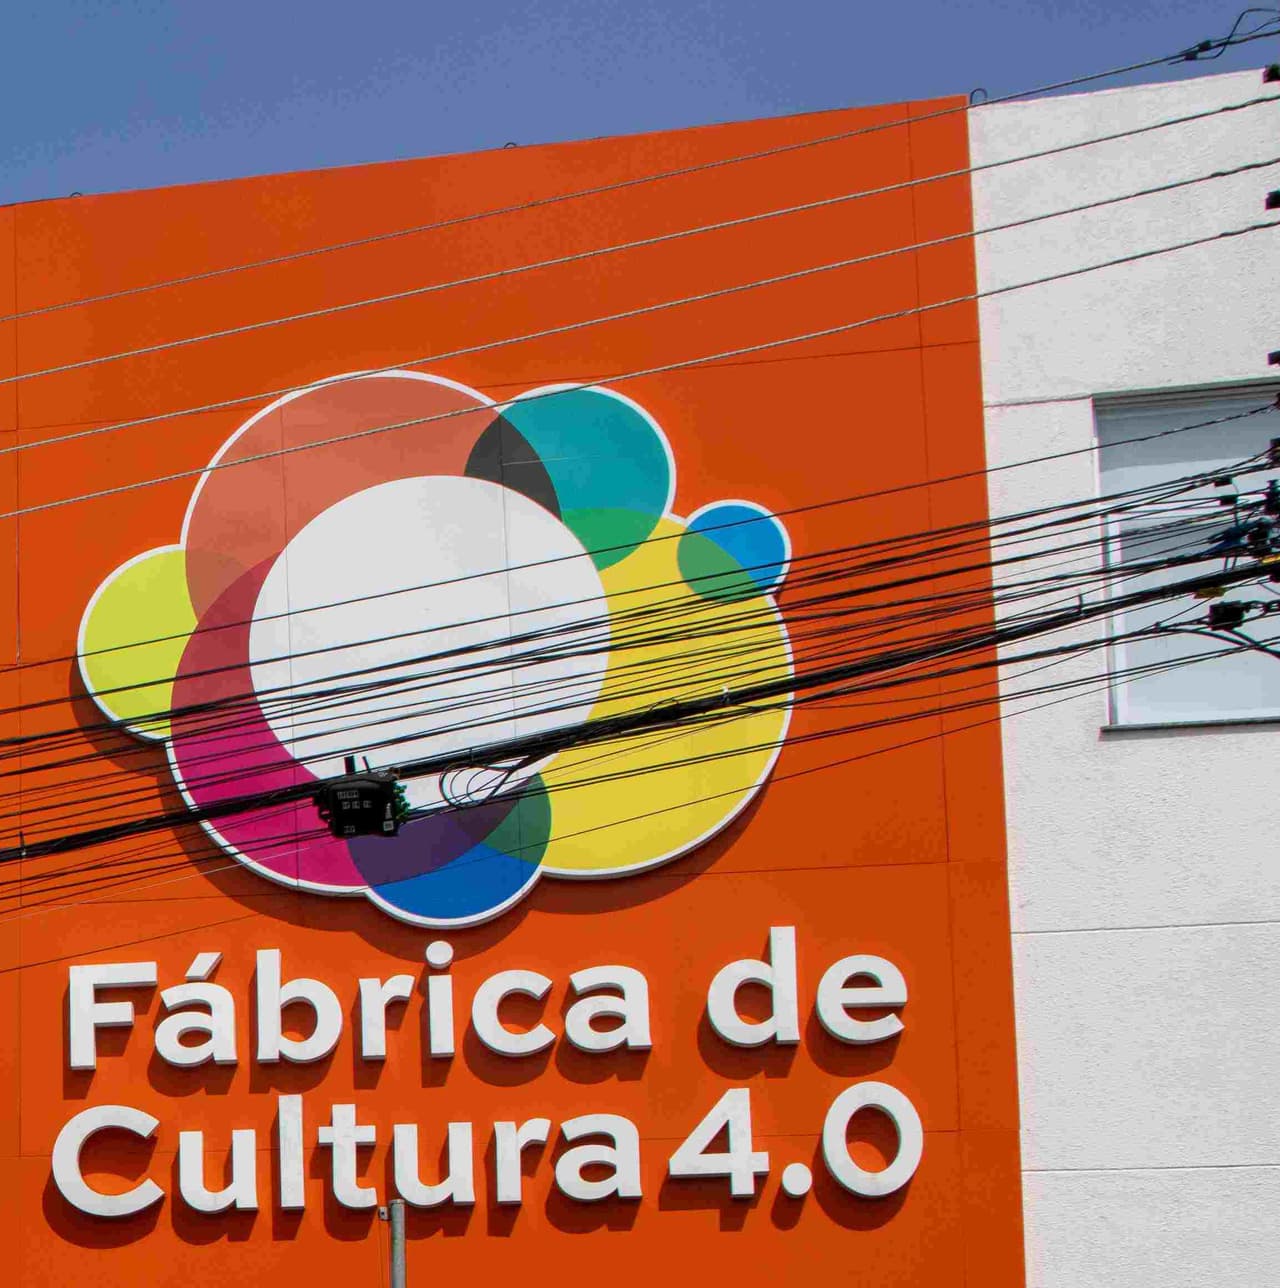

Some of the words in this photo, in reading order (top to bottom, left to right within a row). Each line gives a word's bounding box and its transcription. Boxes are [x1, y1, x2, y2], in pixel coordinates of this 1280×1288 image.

[68, 941, 651, 1071] Fábrica
[706, 926, 906, 1046] de
[50, 1094, 643, 1217] Cultura
[669, 1081, 923, 1200] 4.0
